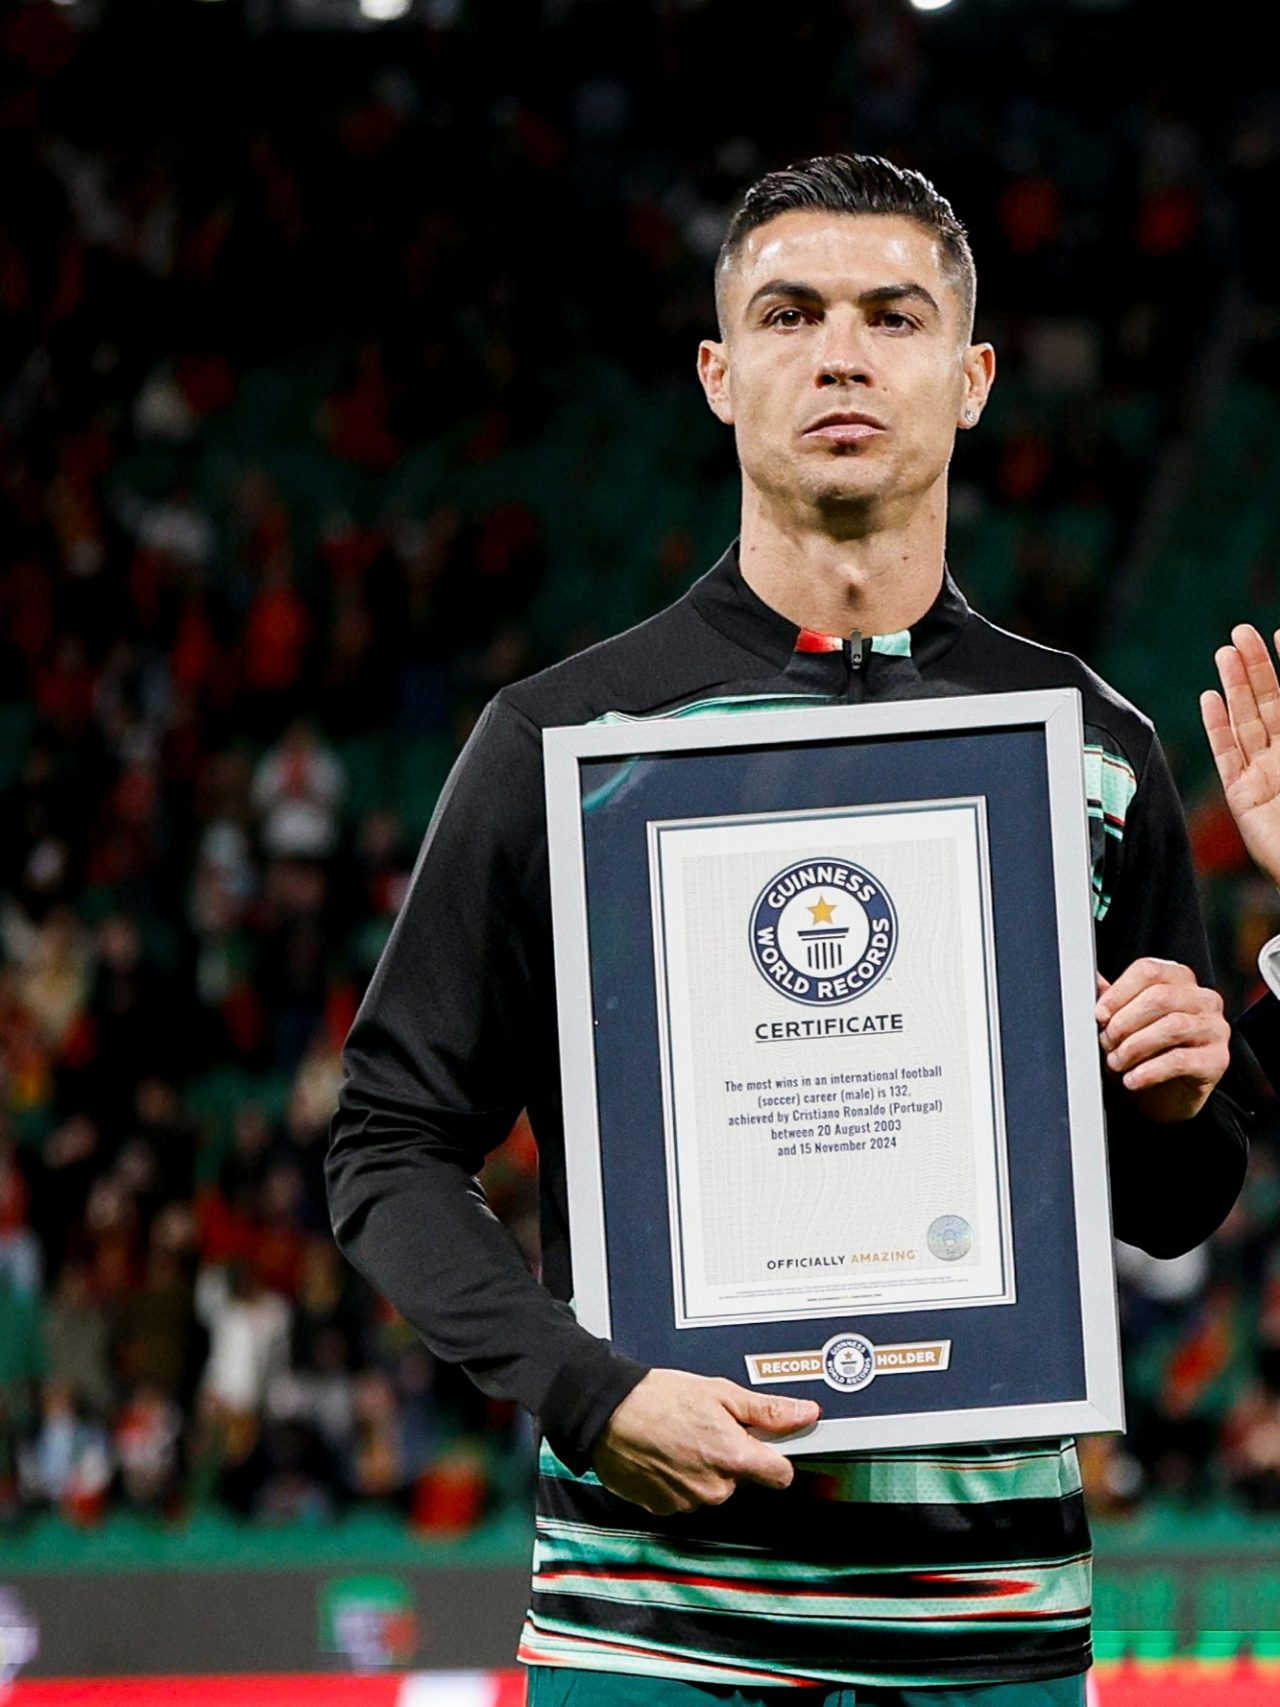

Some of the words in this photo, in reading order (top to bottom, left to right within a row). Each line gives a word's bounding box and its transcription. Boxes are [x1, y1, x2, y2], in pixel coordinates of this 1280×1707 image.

[768, 867, 876, 908] GUINNESS
[757, 926, 810, 994] WORLD
[817, 917, 890, 999] RECORDS
[755, 1014, 903, 1039] CERTIFICATE
[725, 1081, 743, 1092] The
[747, 1079, 772, 1091] most
[776, 1077, 799, 1088] wins
[802, 1076, 811, 1086] in
[815, 1076, 827, 1086] an
[830, 1068, 898, 1085] international
[901, 1066, 942, 1079] football
[758, 1093, 800, 1109] (soccer)
[804, 1093, 837, 1104] career
[841, 1087, 874, 1103] (male)
[878, 1088, 886, 1098] is
[728, 1112, 774, 1126] achieved
[777, 1111, 789, 1124] by
[793, 1109, 840, 1121] Cristiano
[843, 1104, 886, 1117] Ronaldo
[889, 1099, 943, 1116] (Portugal)
[771, 1128, 814, 1140] between
[817, 1124, 831, 1136] 20
[835, 1122, 871, 1136] August
[874, 1119, 902, 1132] 2003
[777, 1144, 797, 1156] and
[800, 1142, 812, 1154] 15
[815, 1140, 866, 1153] November
[870, 1136, 897, 1149] 2024
[767, 1255, 846, 1270] OFFICIALLY
[850, 1250, 916, 1264] AMAZING
[830, 1341, 866, 1355] GUINNESS
[761, 1360, 821, 1374] RECORD
[877, 1351, 936, 1366] HOLDER
